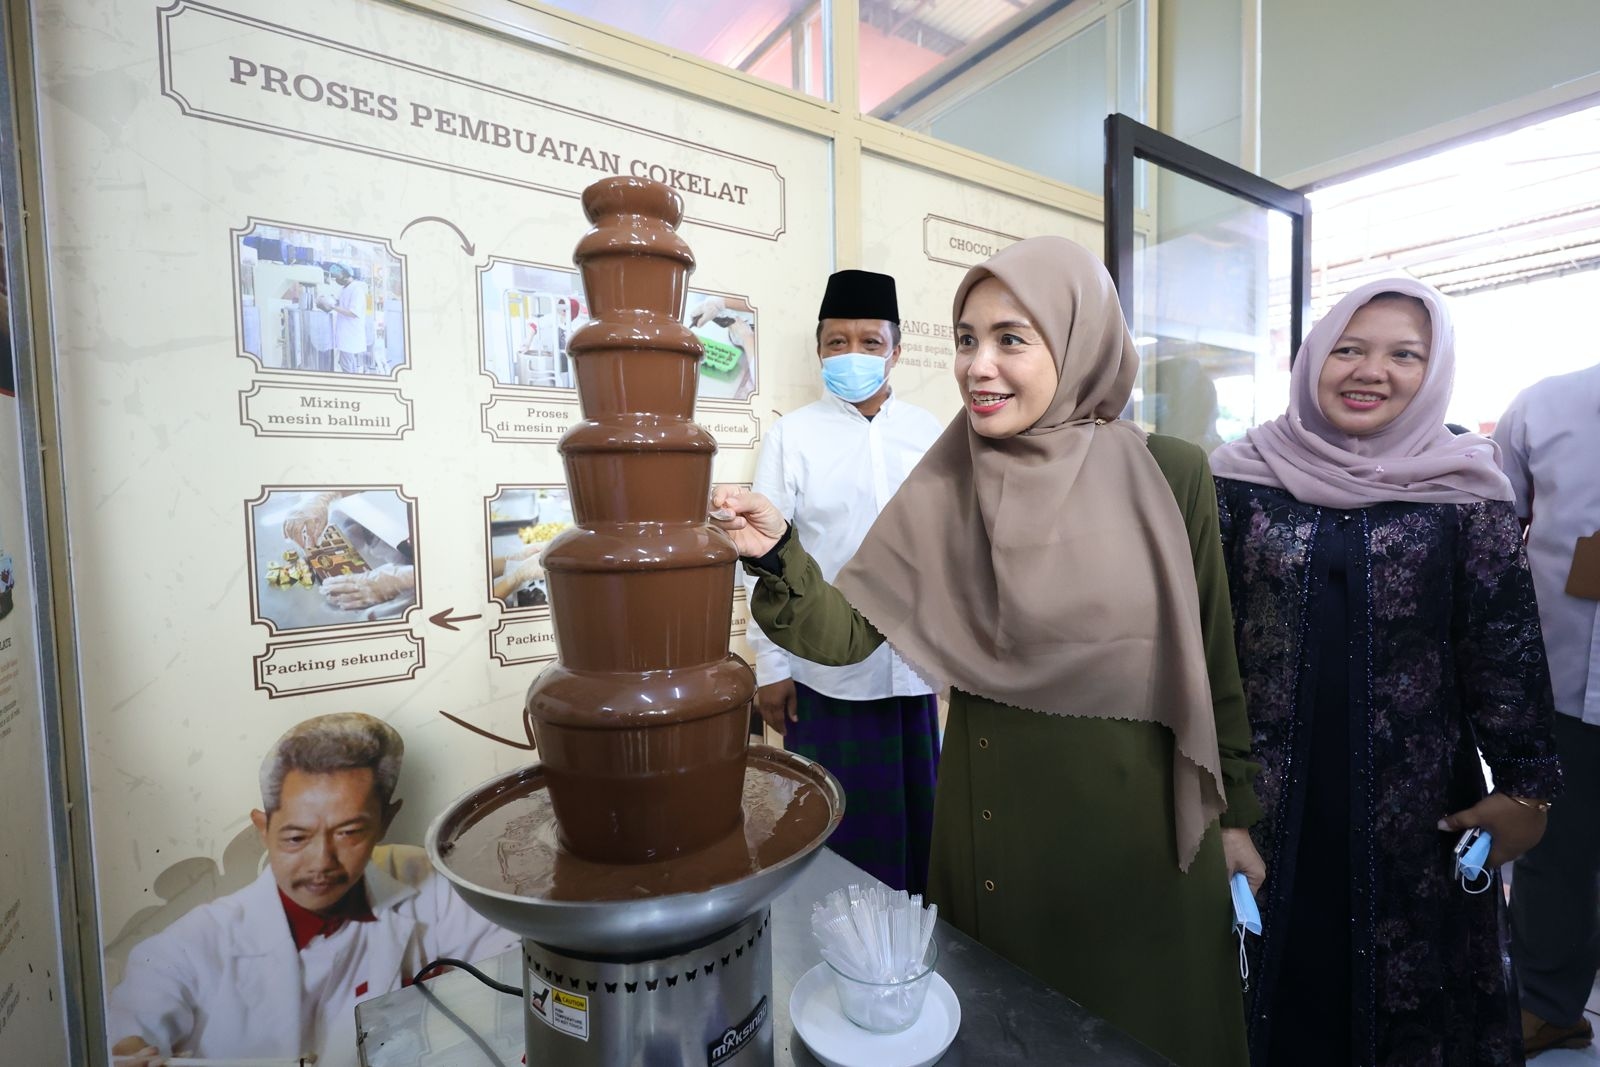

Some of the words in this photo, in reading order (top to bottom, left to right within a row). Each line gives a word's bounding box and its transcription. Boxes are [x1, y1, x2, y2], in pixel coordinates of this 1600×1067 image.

[229, 56, 398, 121] PROSES
[410, 102, 620, 175] PEMBUATAN
[630, 160, 748, 205] COKELAT
[949, 237, 999, 257] CHOCOL
[300, 396, 360, 411] Mixing
[267, 414, 322, 425] mesin
[328, 414, 390, 427] ballmill
[527, 408, 569, 419] Proses
[497, 421, 509, 431] di
[514, 422, 552, 433] mesin
[714, 423, 749, 433] dicetak
[266, 659, 336, 675] Packing
[341, 649, 415, 667] sekunder
